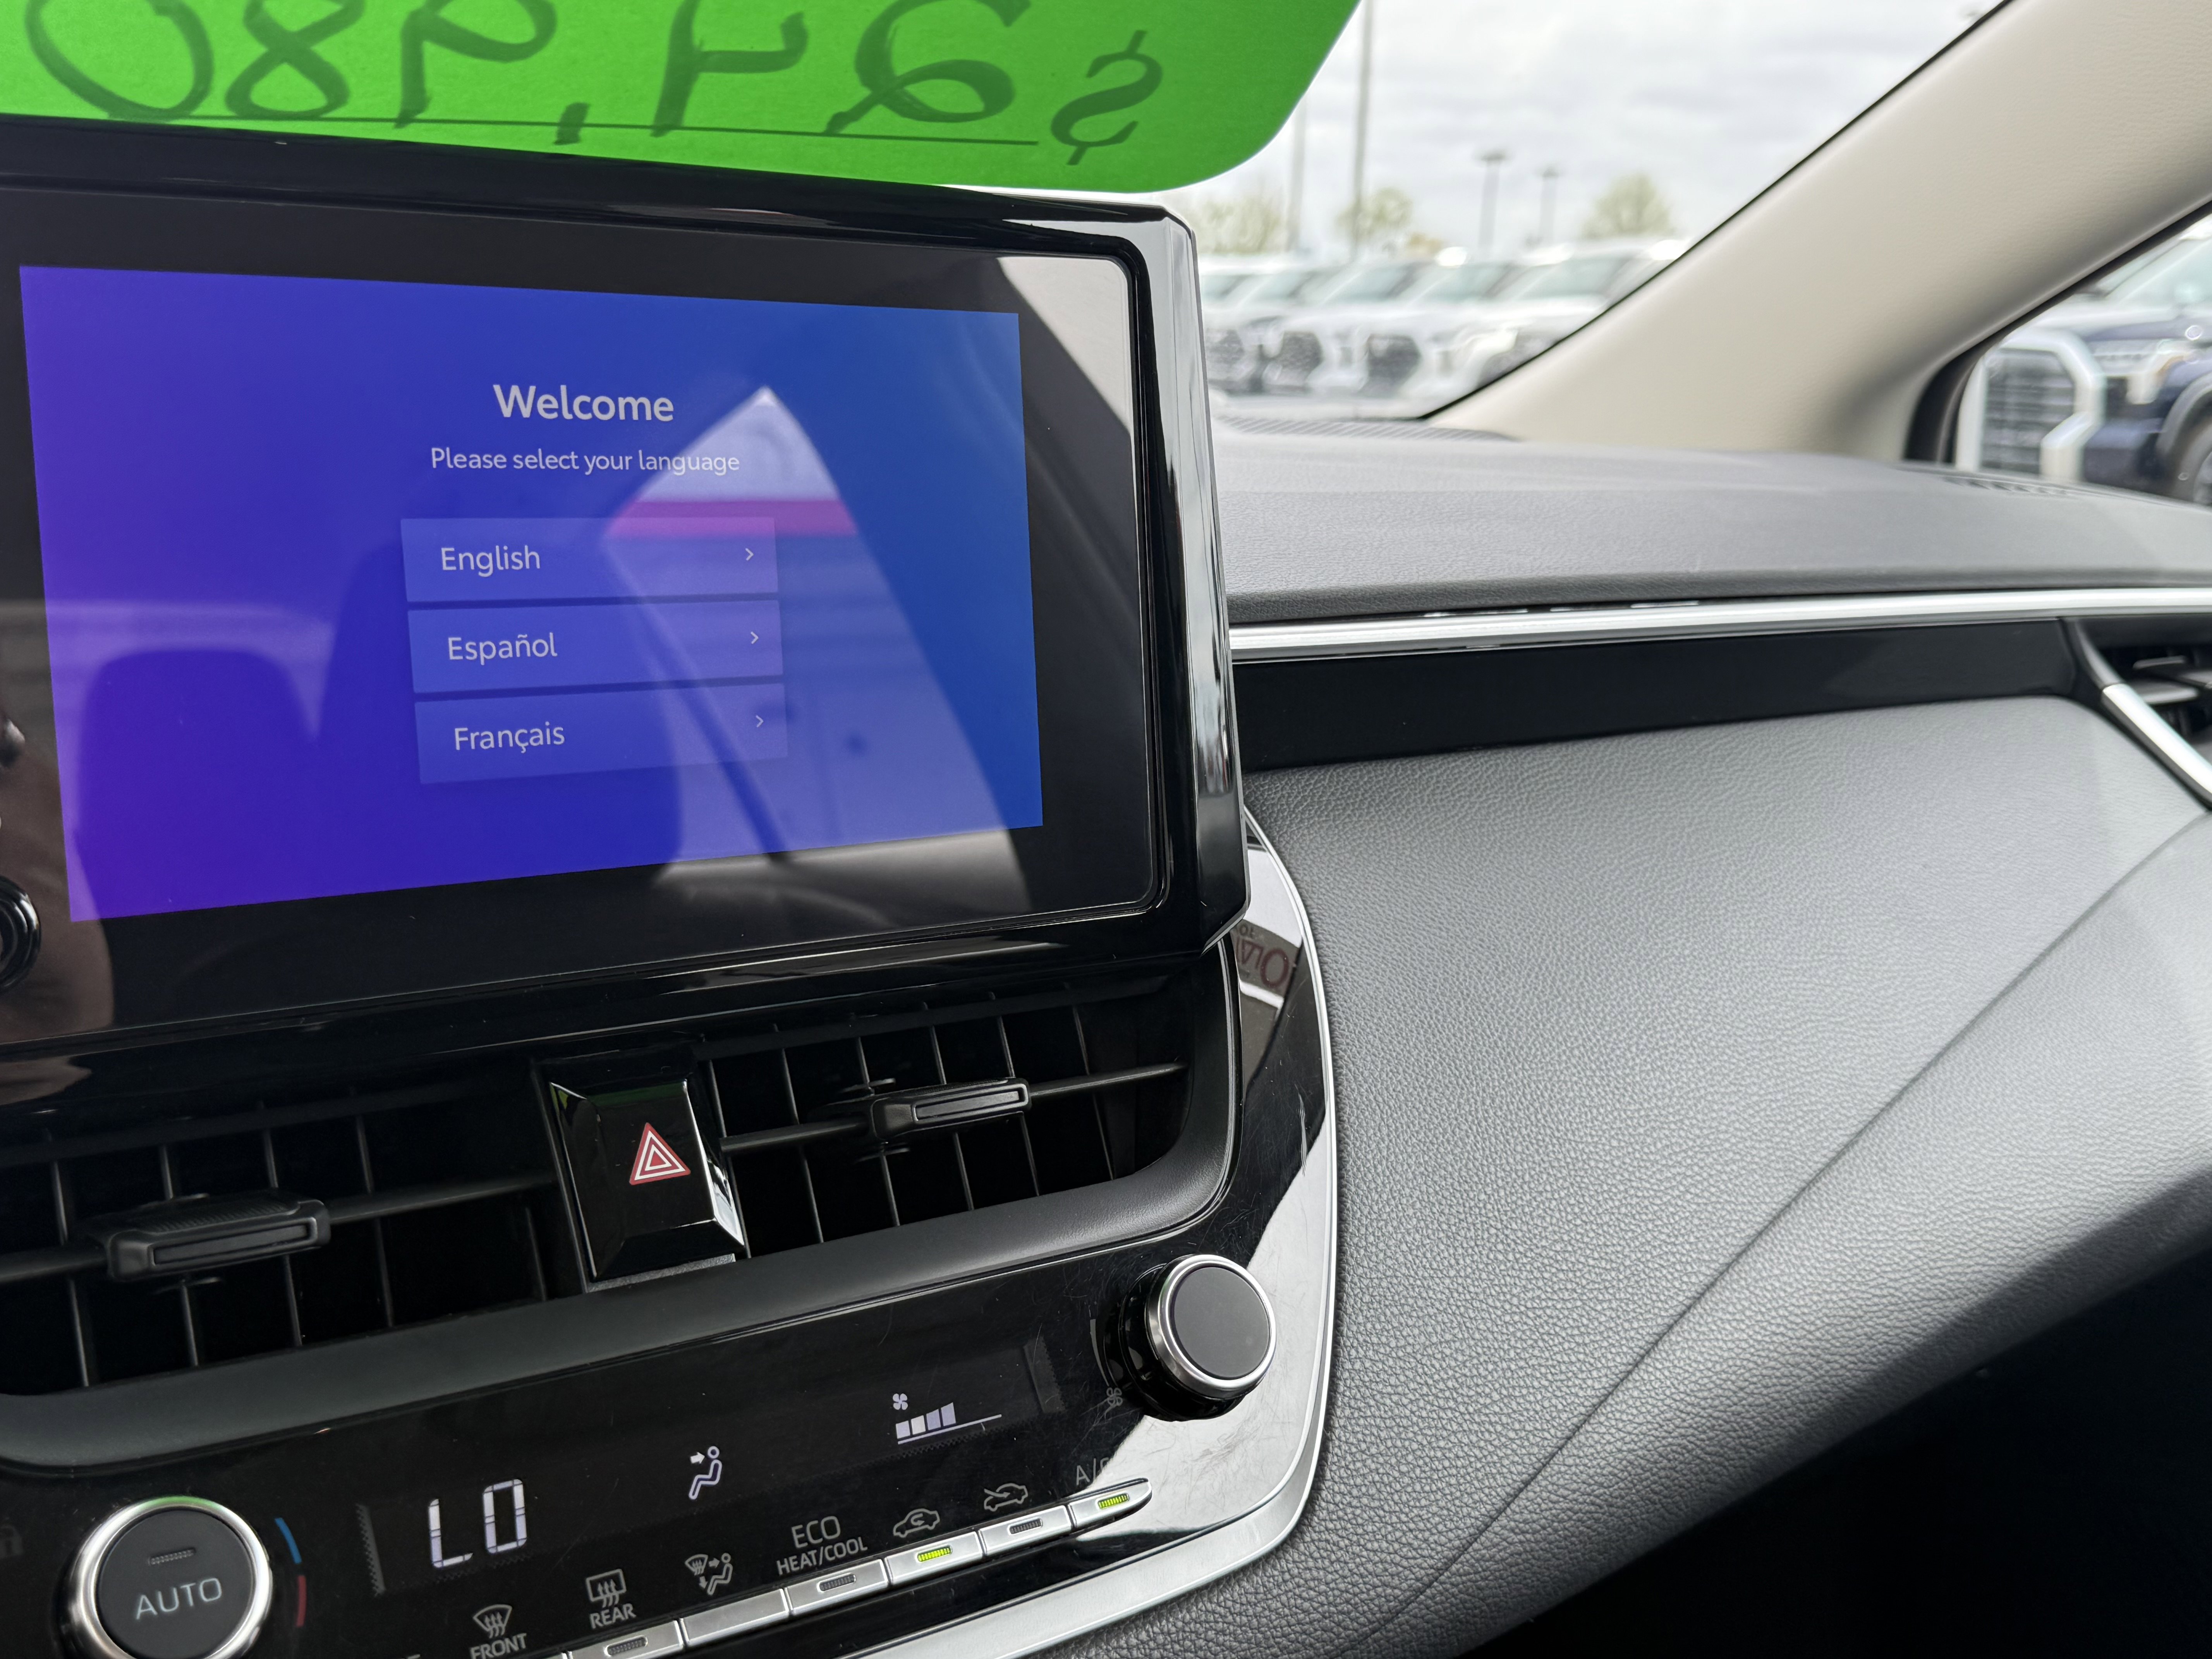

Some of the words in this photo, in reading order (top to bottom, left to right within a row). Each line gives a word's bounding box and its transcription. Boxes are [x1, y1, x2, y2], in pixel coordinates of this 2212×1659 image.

[493, 384, 674, 422] Welcome
[431, 447, 507, 469] Please
[513, 448, 579, 470] select
[584, 454, 633, 475] your
[638, 450, 740, 476] language
[441, 544, 541, 577] English
[448, 632, 558, 665] Español
[455, 721, 565, 753] Français
[791, 1516, 841, 1548] ECO
[777, 1537, 867, 1575] HEAT/COOL
[135, 1577, 222, 1620] AUTO
[590, 1604, 636, 1628] REAR
[470, 1633, 527, 1659] FRONT
